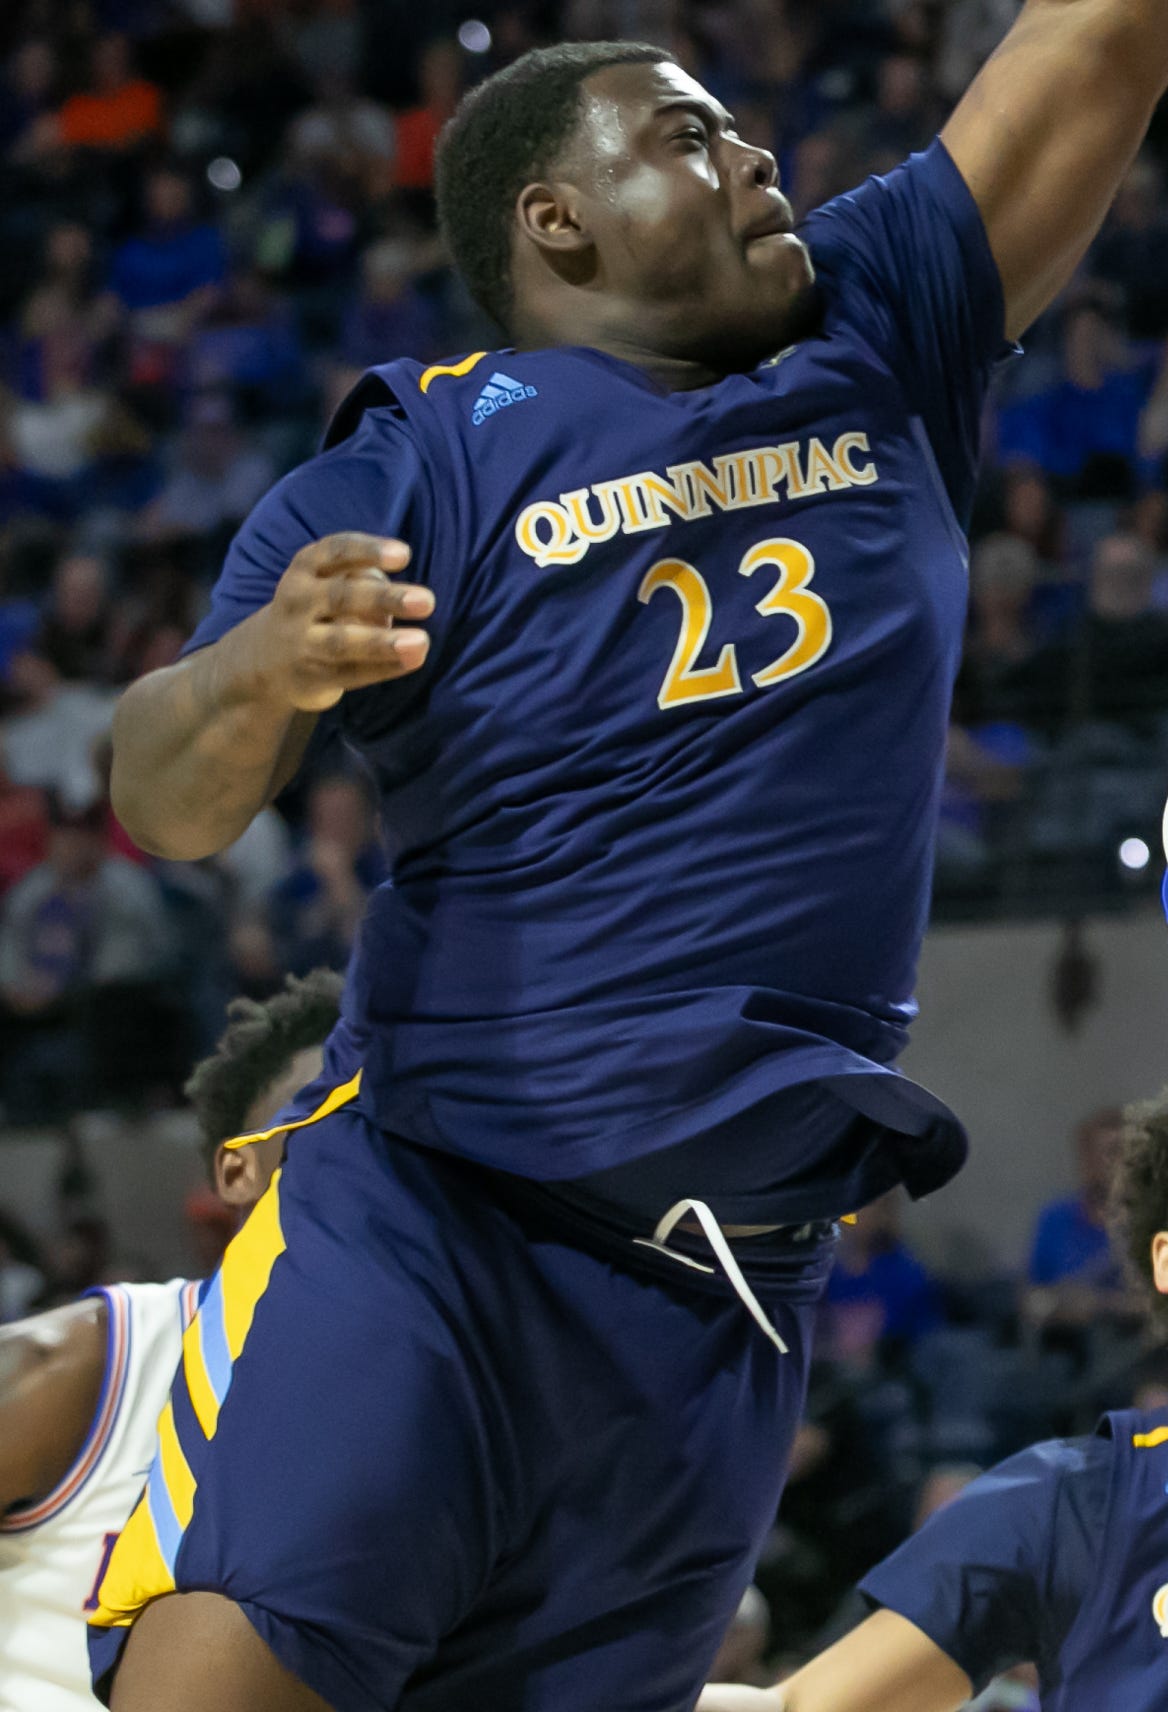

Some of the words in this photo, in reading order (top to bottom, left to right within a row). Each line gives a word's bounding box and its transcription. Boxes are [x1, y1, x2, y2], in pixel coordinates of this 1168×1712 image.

[472, 386, 538, 426] adidas
[515, 432, 879, 568] QUINNIPIAC
[637, 537, 833, 711] 23
